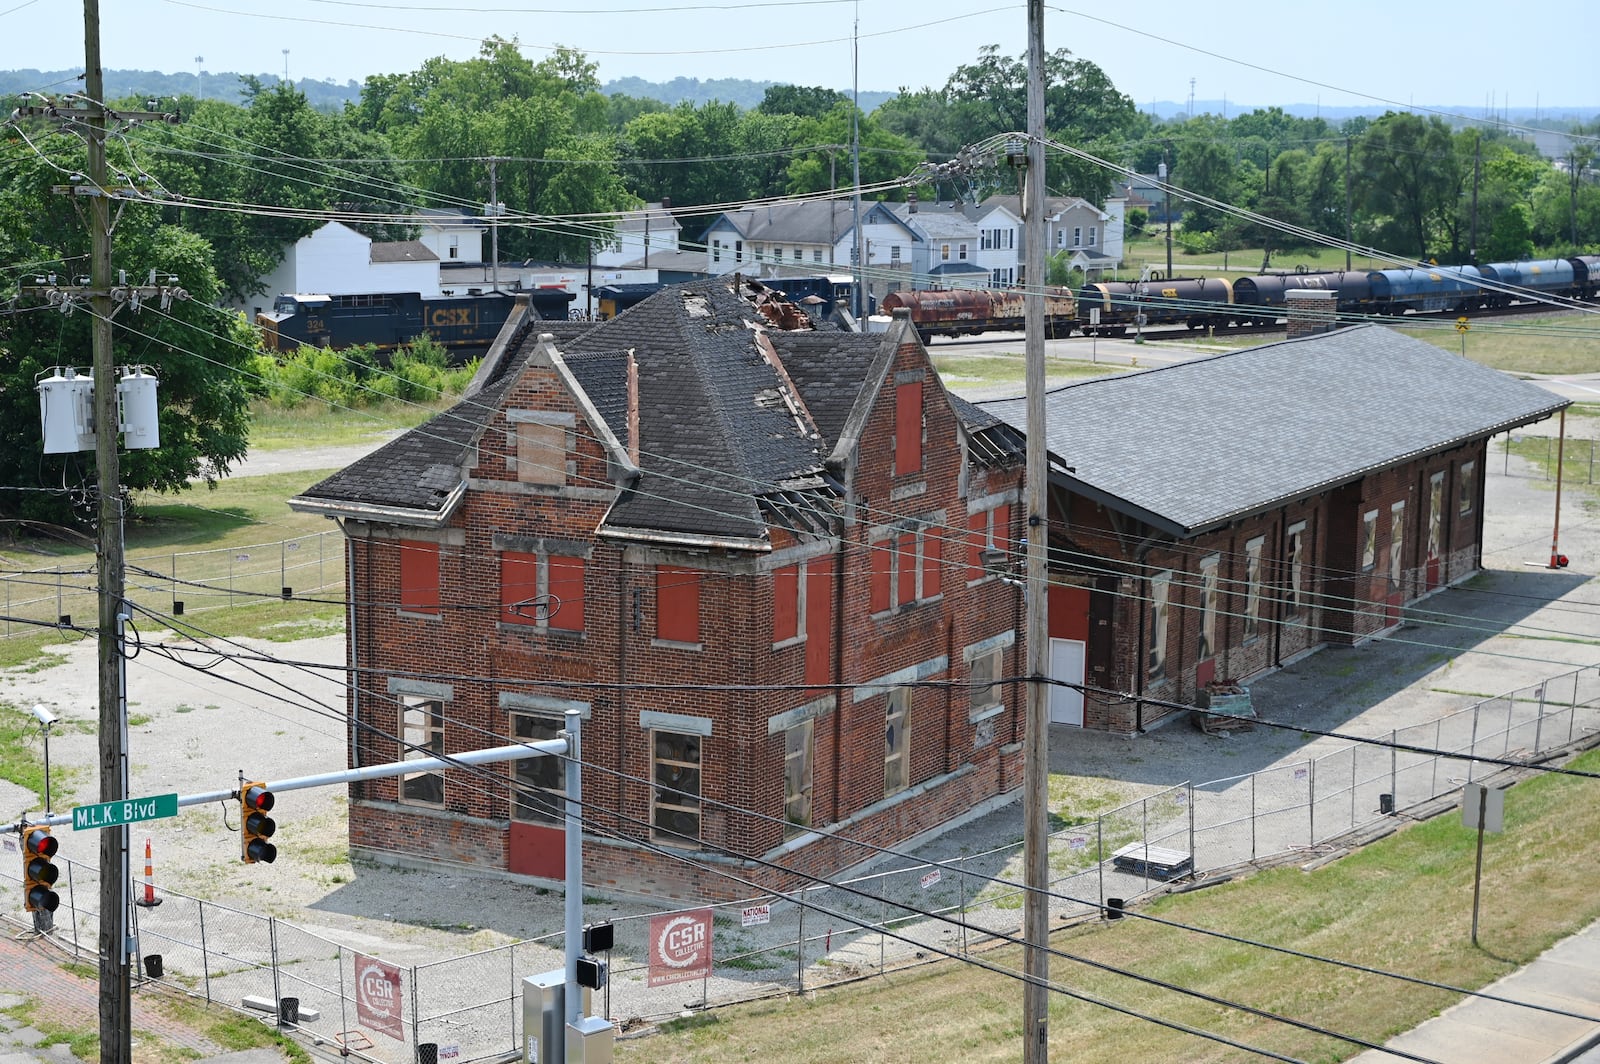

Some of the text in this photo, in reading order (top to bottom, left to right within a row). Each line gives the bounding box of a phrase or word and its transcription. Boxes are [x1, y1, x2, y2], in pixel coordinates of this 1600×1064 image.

[306, 319, 324, 329] 324
[432, 308, 471, 326] CSX
[77, 800, 156, 827] M.L.K. Blvd
[743, 905, 769, 917] NATIONAL
[669, 923, 705, 950] CSR
[675, 941, 704, 957] COLLECTIVE
[366, 977, 394, 999] CSR
